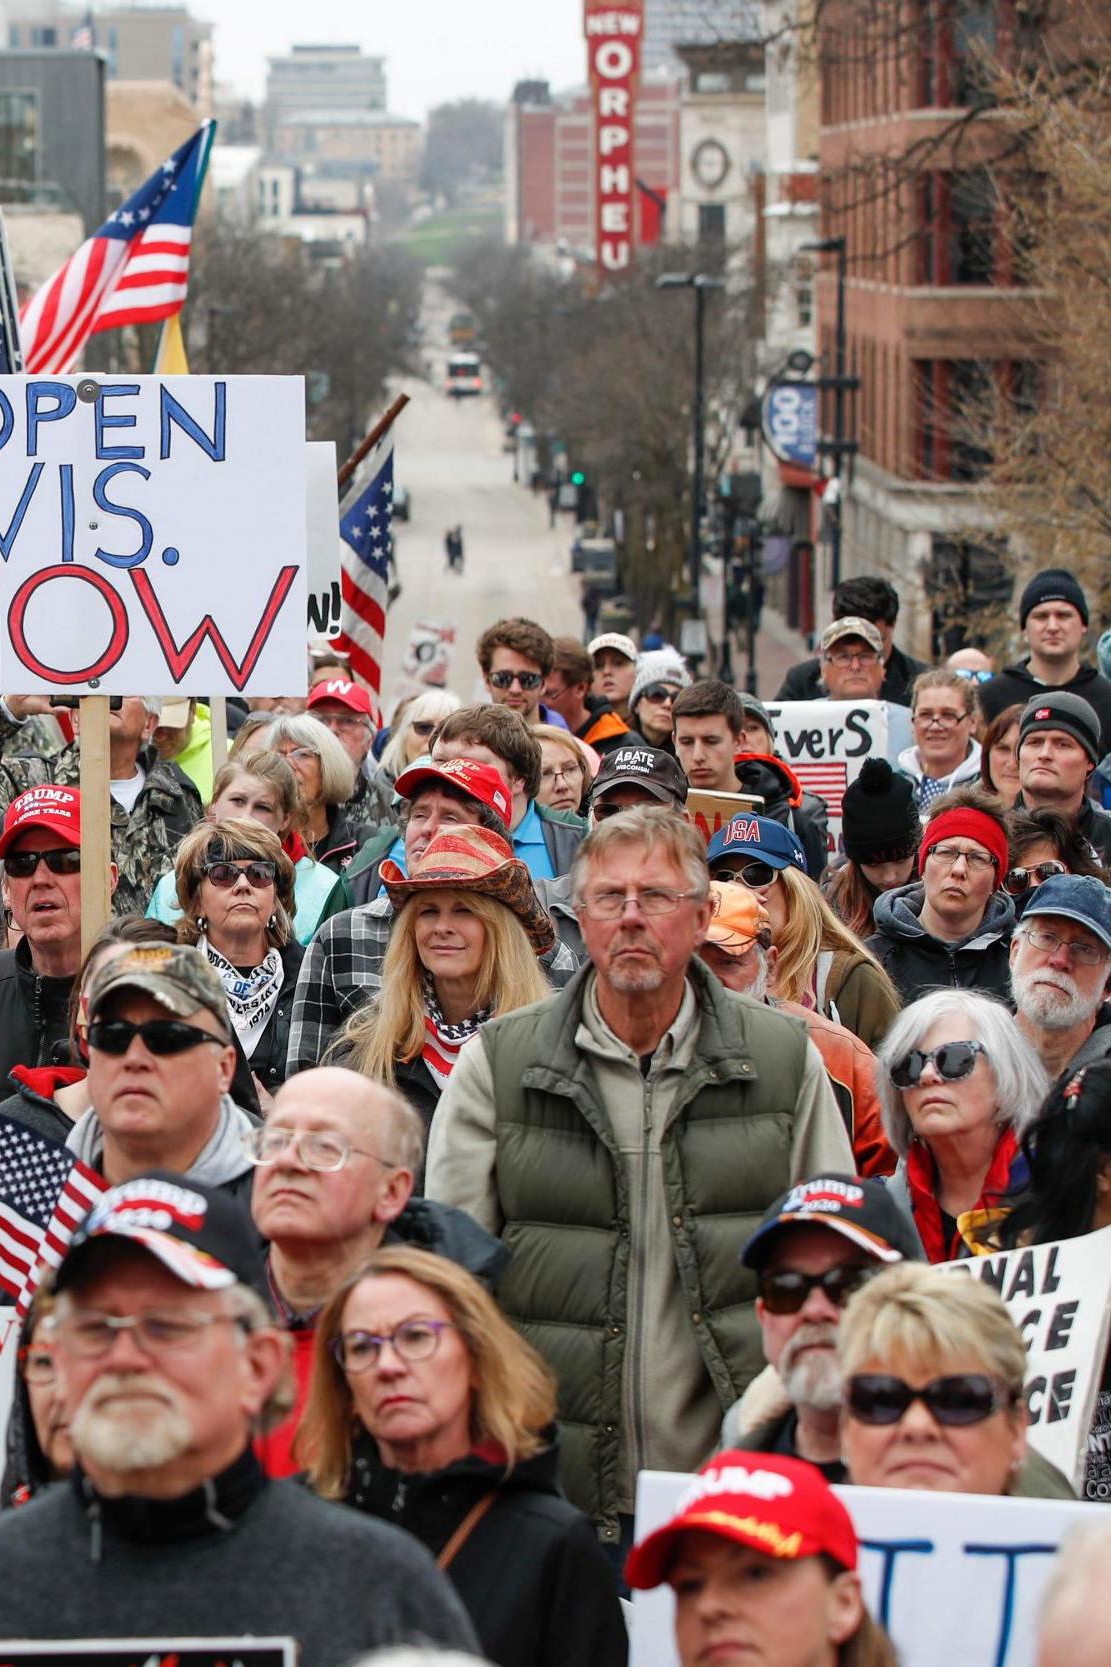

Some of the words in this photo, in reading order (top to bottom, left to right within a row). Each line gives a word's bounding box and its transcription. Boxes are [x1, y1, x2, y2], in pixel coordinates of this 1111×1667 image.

[586, 13, 639, 37] NEW
[325, 679, 353, 695] W
[614, 750, 655, 768] ABATE
[616, 765, 650, 774] WISCONSIN
[14, 788, 75, 813] TRUMP
[42, 808, 72, 818] YEARS
